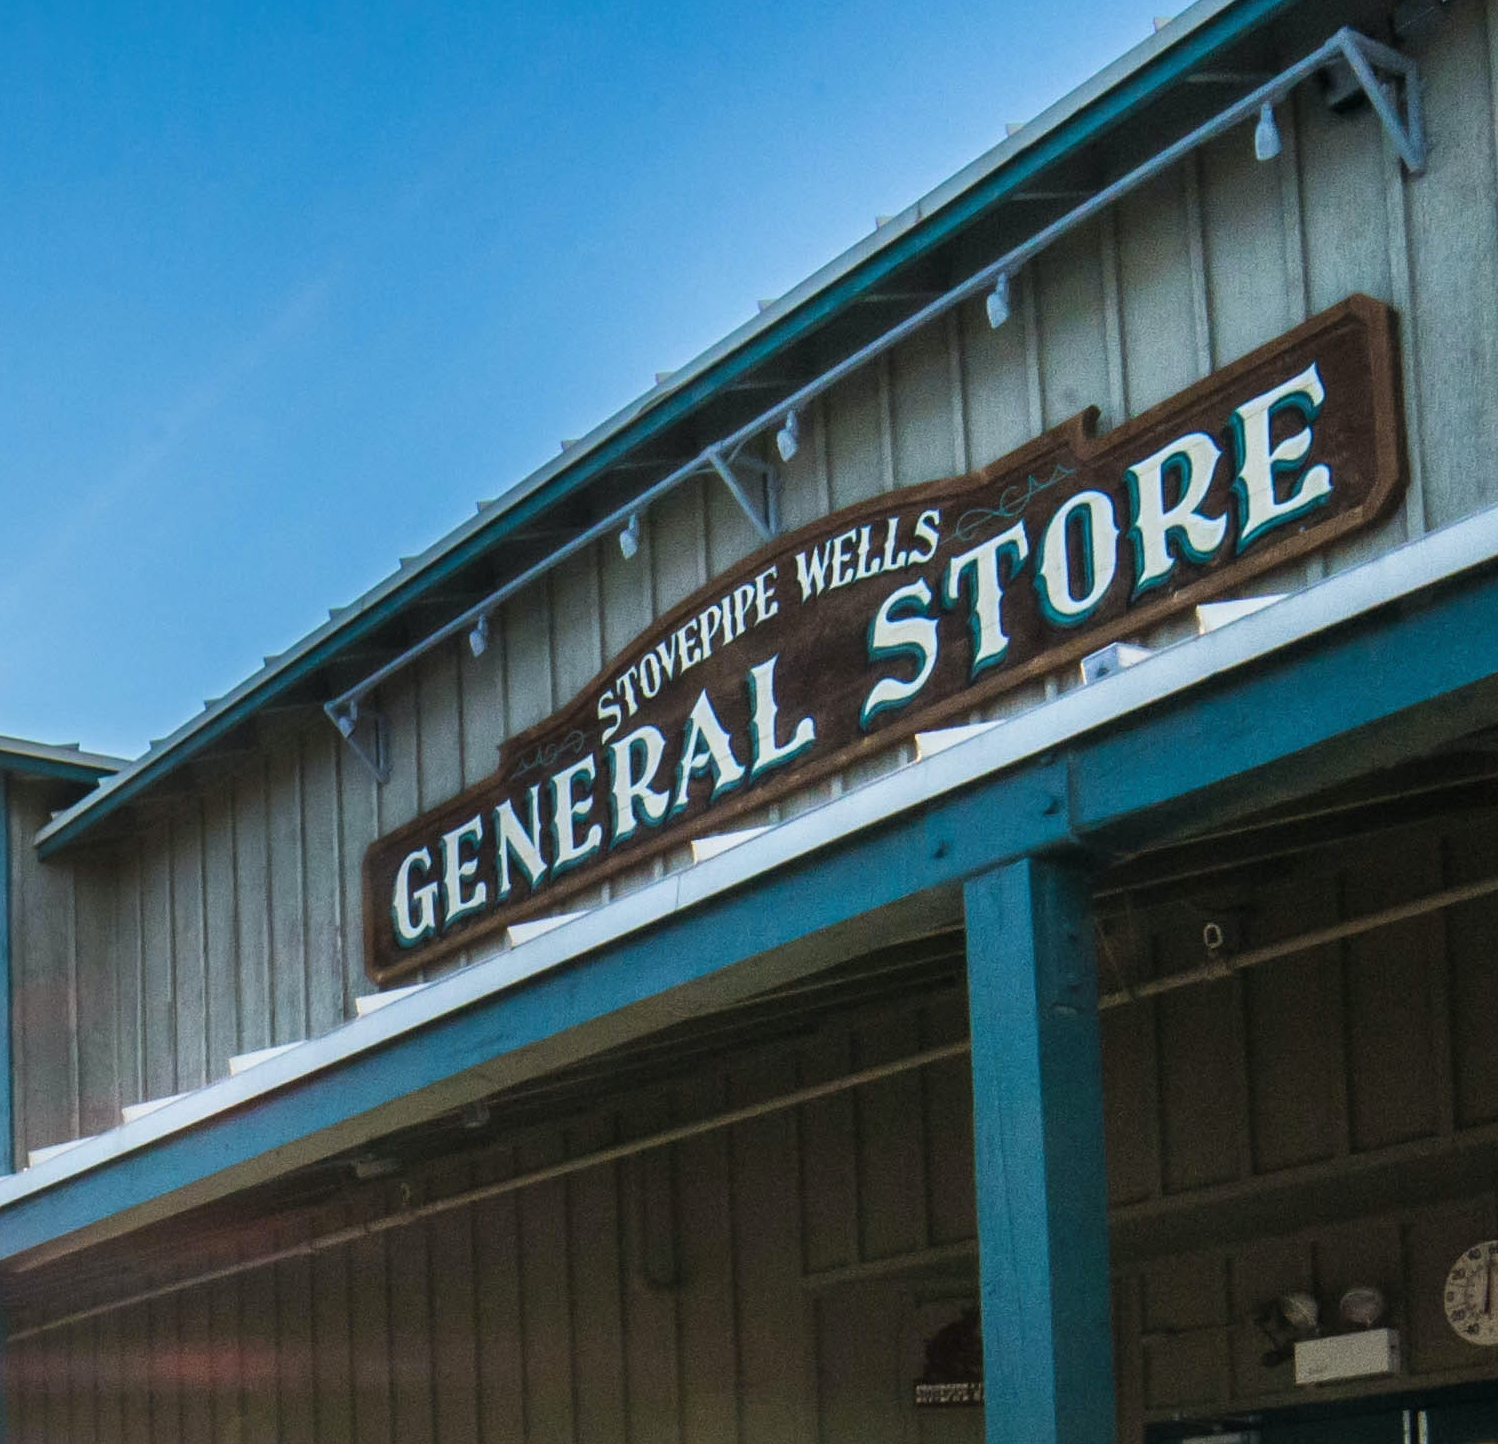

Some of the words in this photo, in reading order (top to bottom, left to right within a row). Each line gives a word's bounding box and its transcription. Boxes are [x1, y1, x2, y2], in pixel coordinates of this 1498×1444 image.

[390, 654, 817, 950] GENERAL
[859, 361, 1334, 732] STORE
[597, 566, 778, 741] STOVEPIPE
[794, 508, 941, 600] WELLS
